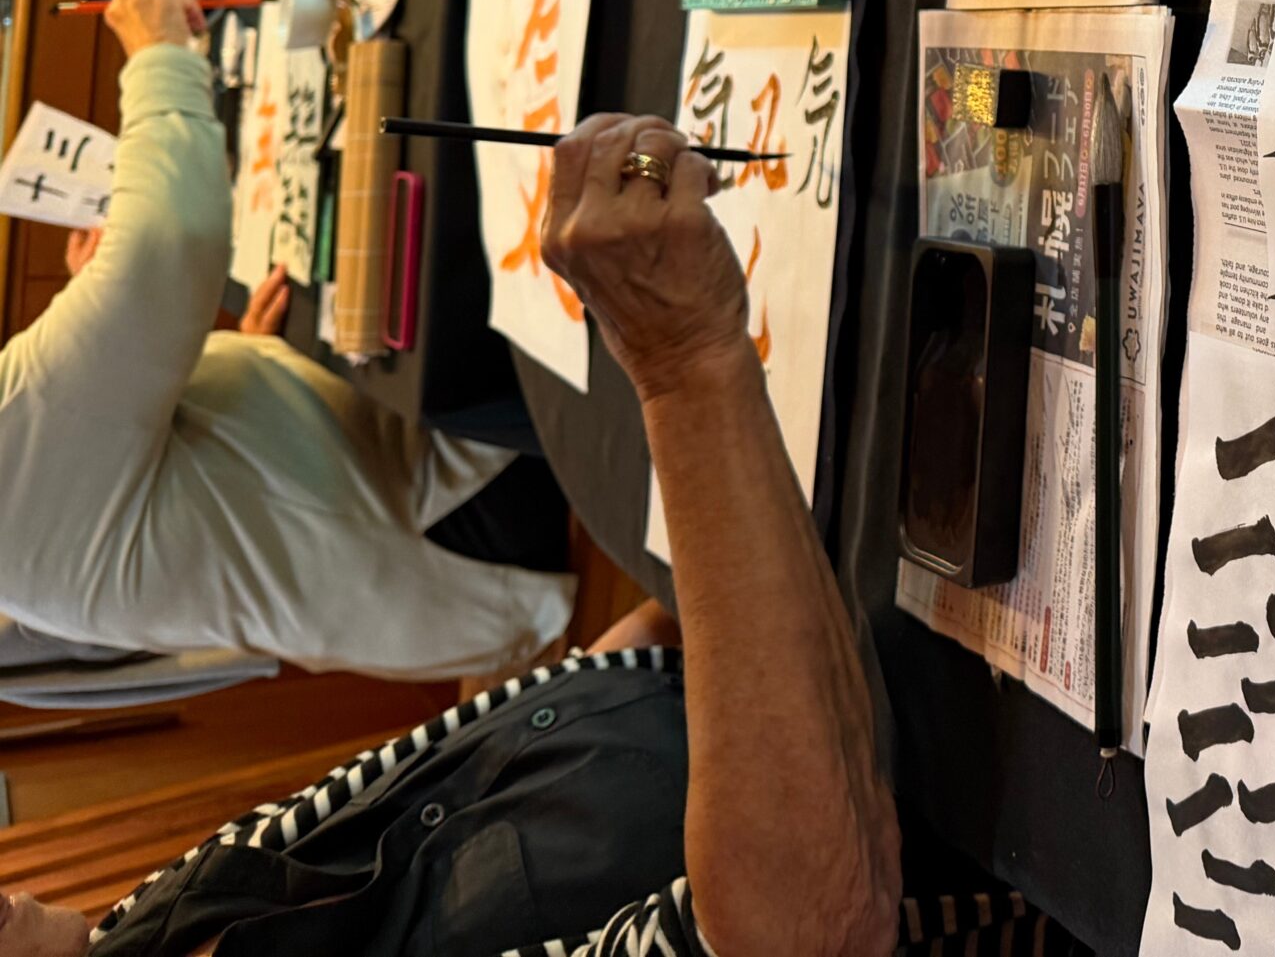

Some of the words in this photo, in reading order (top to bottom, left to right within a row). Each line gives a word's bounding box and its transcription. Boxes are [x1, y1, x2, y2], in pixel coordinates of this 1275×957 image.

[963, 193, 977, 225] off
[1235, 262, 1247, 272] and
[1220, 268, 1238, 282] temple
[1219, 280, 1232, 291] cook
[1239, 273, 1269, 290] community
[1218, 290, 1229, 301] and
[1229, 292, 1246, 306] down,
[1239, 287, 1259, 300] kitchen
[1217, 301, 1229, 313] who
[1251, 300, 1264, 312] take
[1216, 312, 1227, 324] this
[1230, 305, 1258, 321] volunteers
[1230, 316, 1252, 330] manage
[1215, 324, 1227, 335] who
[1236, 330, 1244, 340] to
[1244, 333, 1255, 343] out
